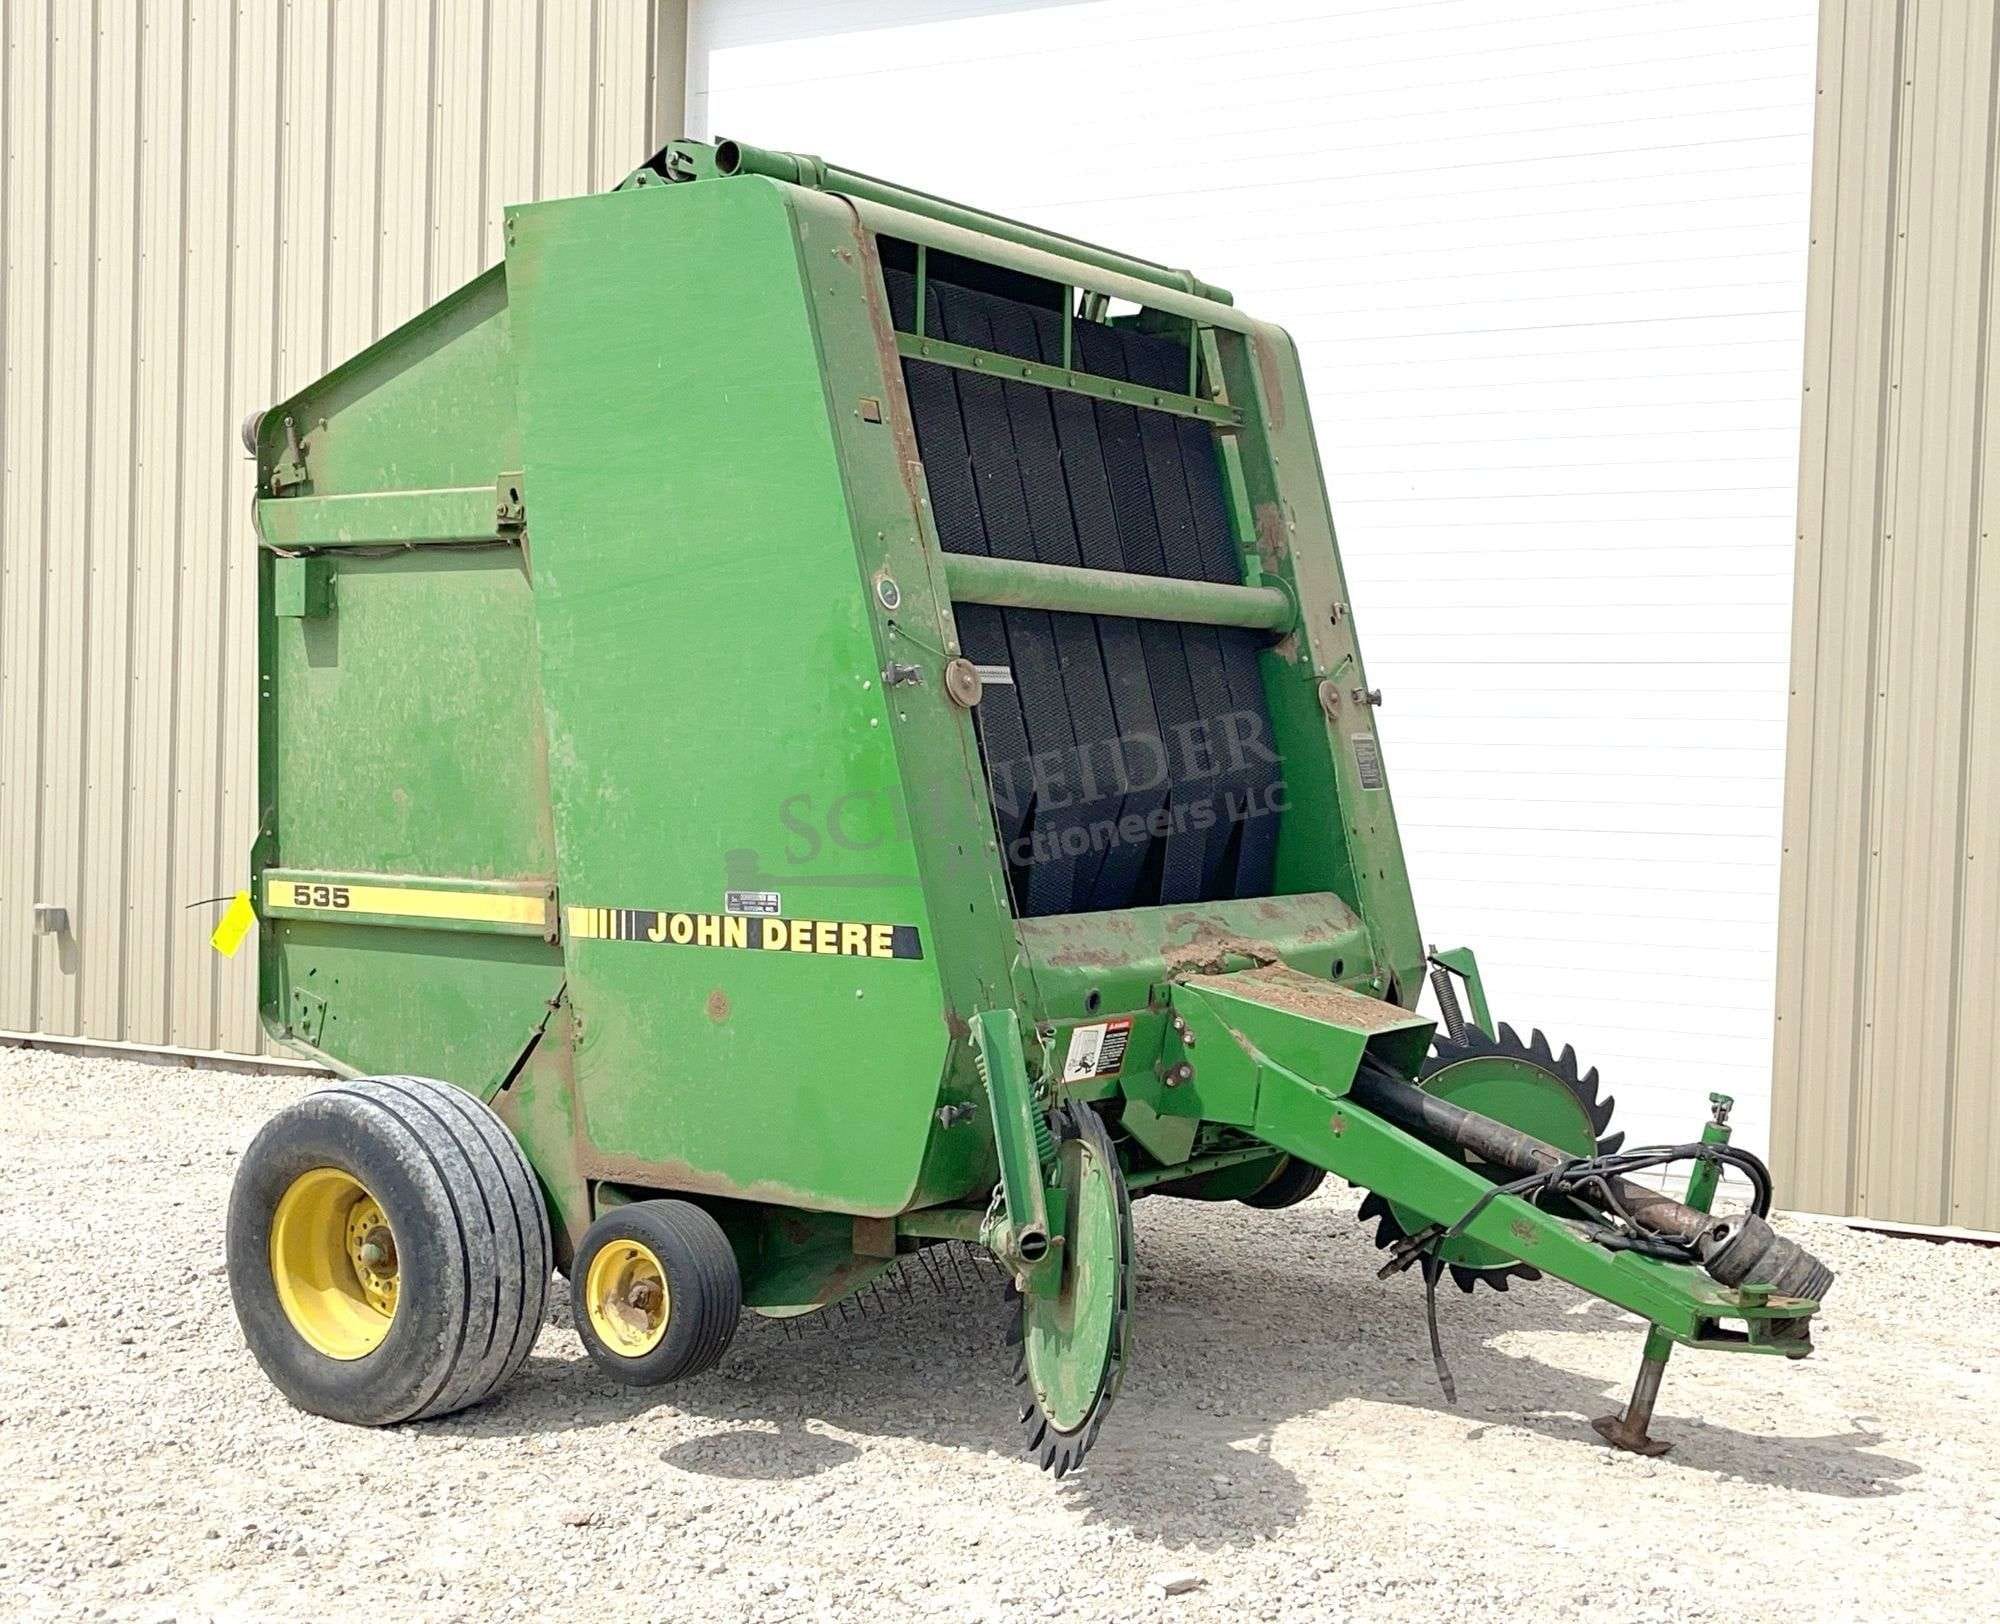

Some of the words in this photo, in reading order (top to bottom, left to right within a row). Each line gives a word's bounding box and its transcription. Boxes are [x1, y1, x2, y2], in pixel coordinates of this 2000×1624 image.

[294, 884, 350, 908] 535
[647, 912, 748, 949] JOHN
[762, 918, 894, 958] DEERE
